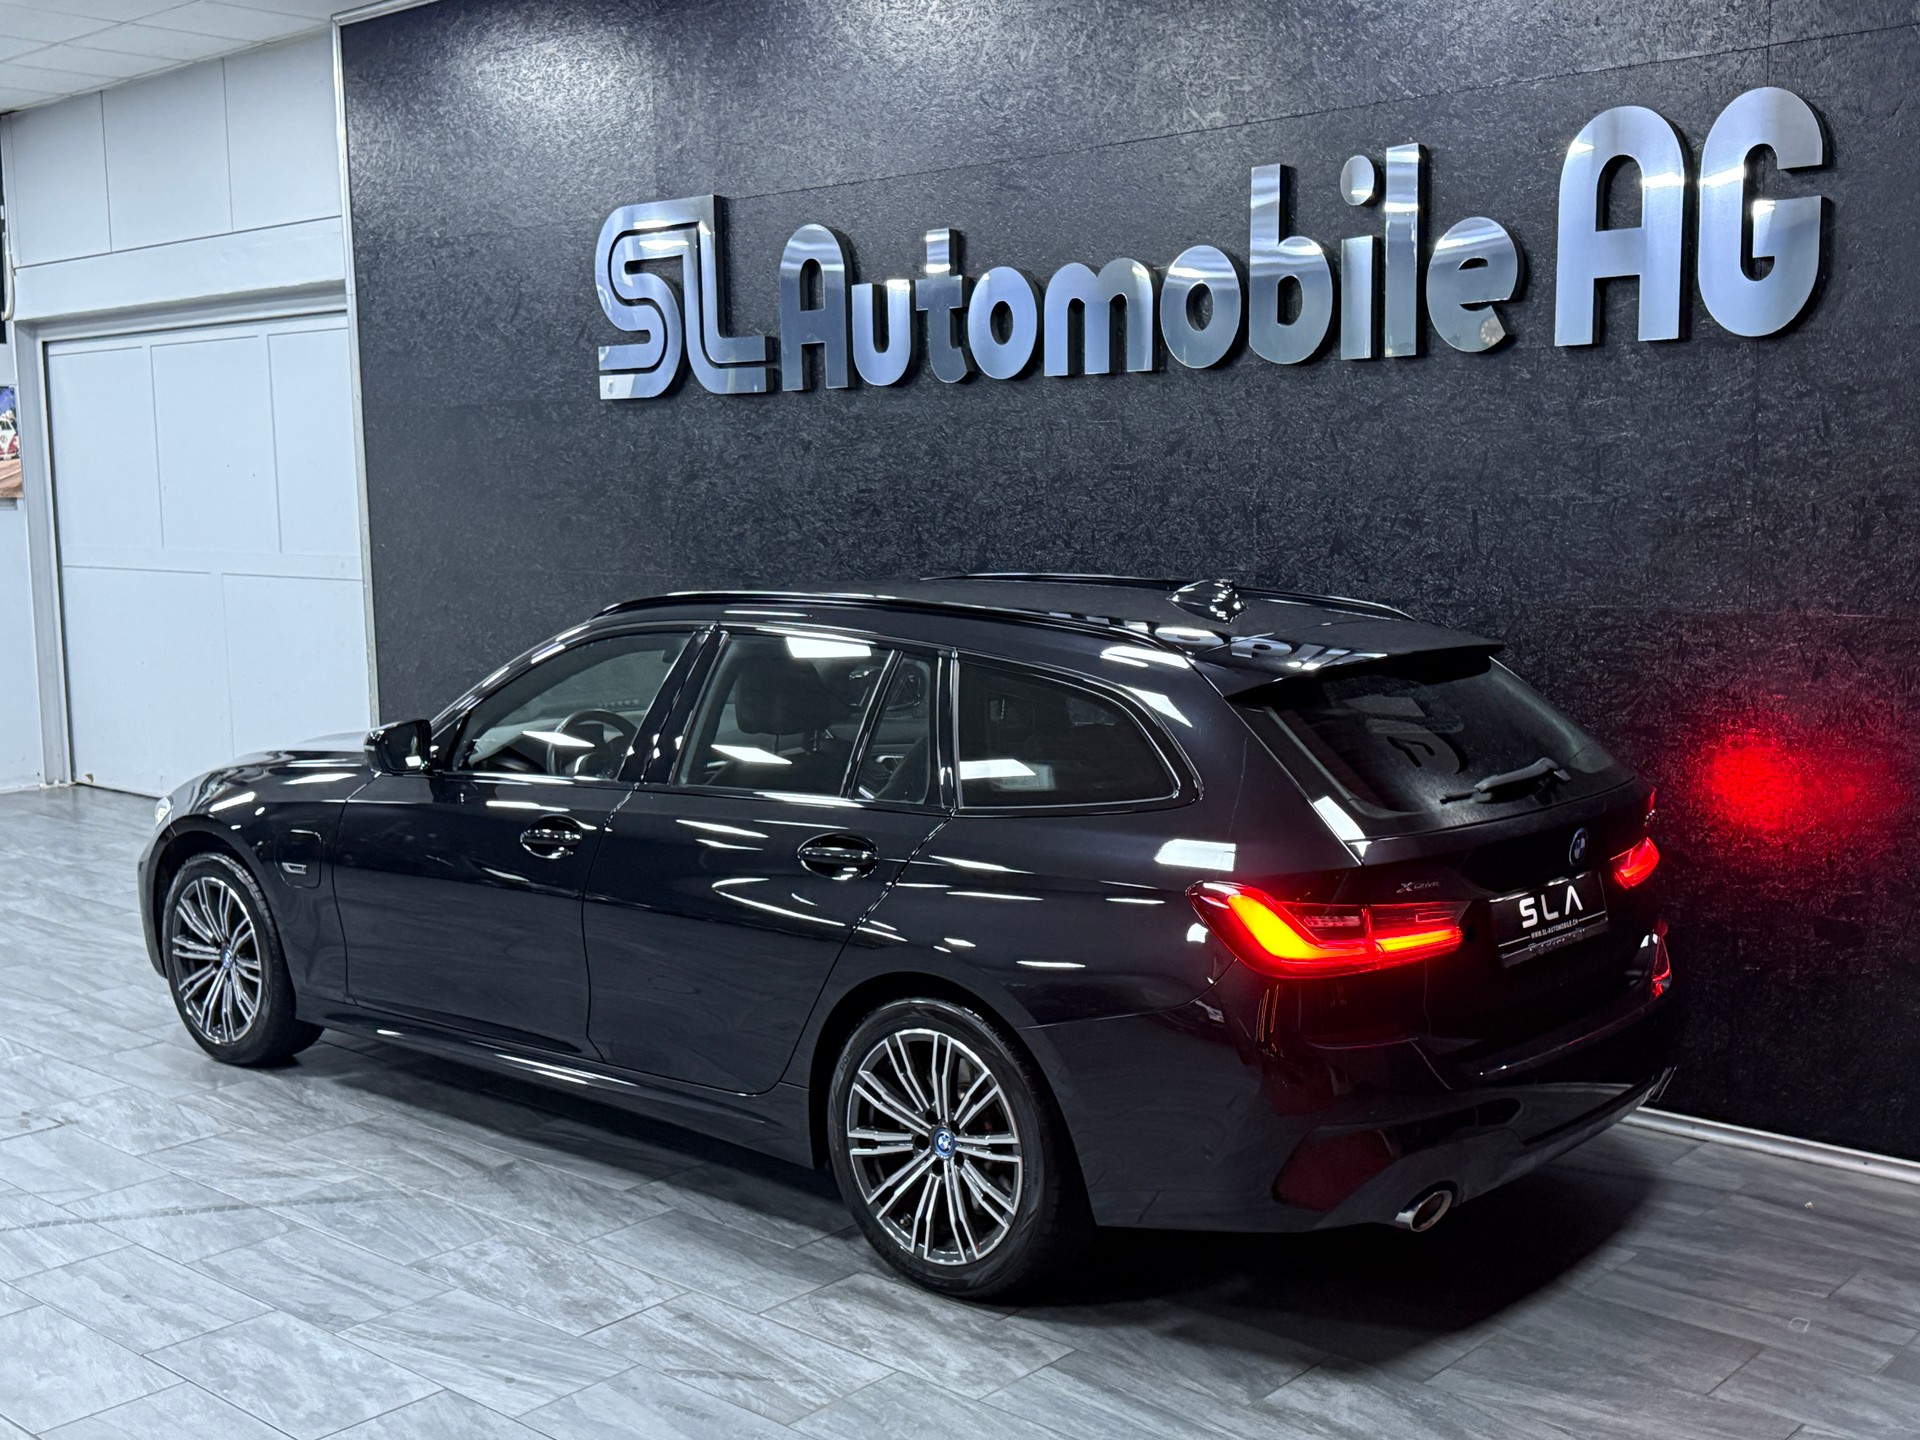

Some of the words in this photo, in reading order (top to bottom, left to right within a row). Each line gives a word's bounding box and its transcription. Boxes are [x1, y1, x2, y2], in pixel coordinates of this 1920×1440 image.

[594, 194, 767, 399] SL
[779, 143, 1520, 392] Automobile
[1554, 86, 1824, 347] AG
